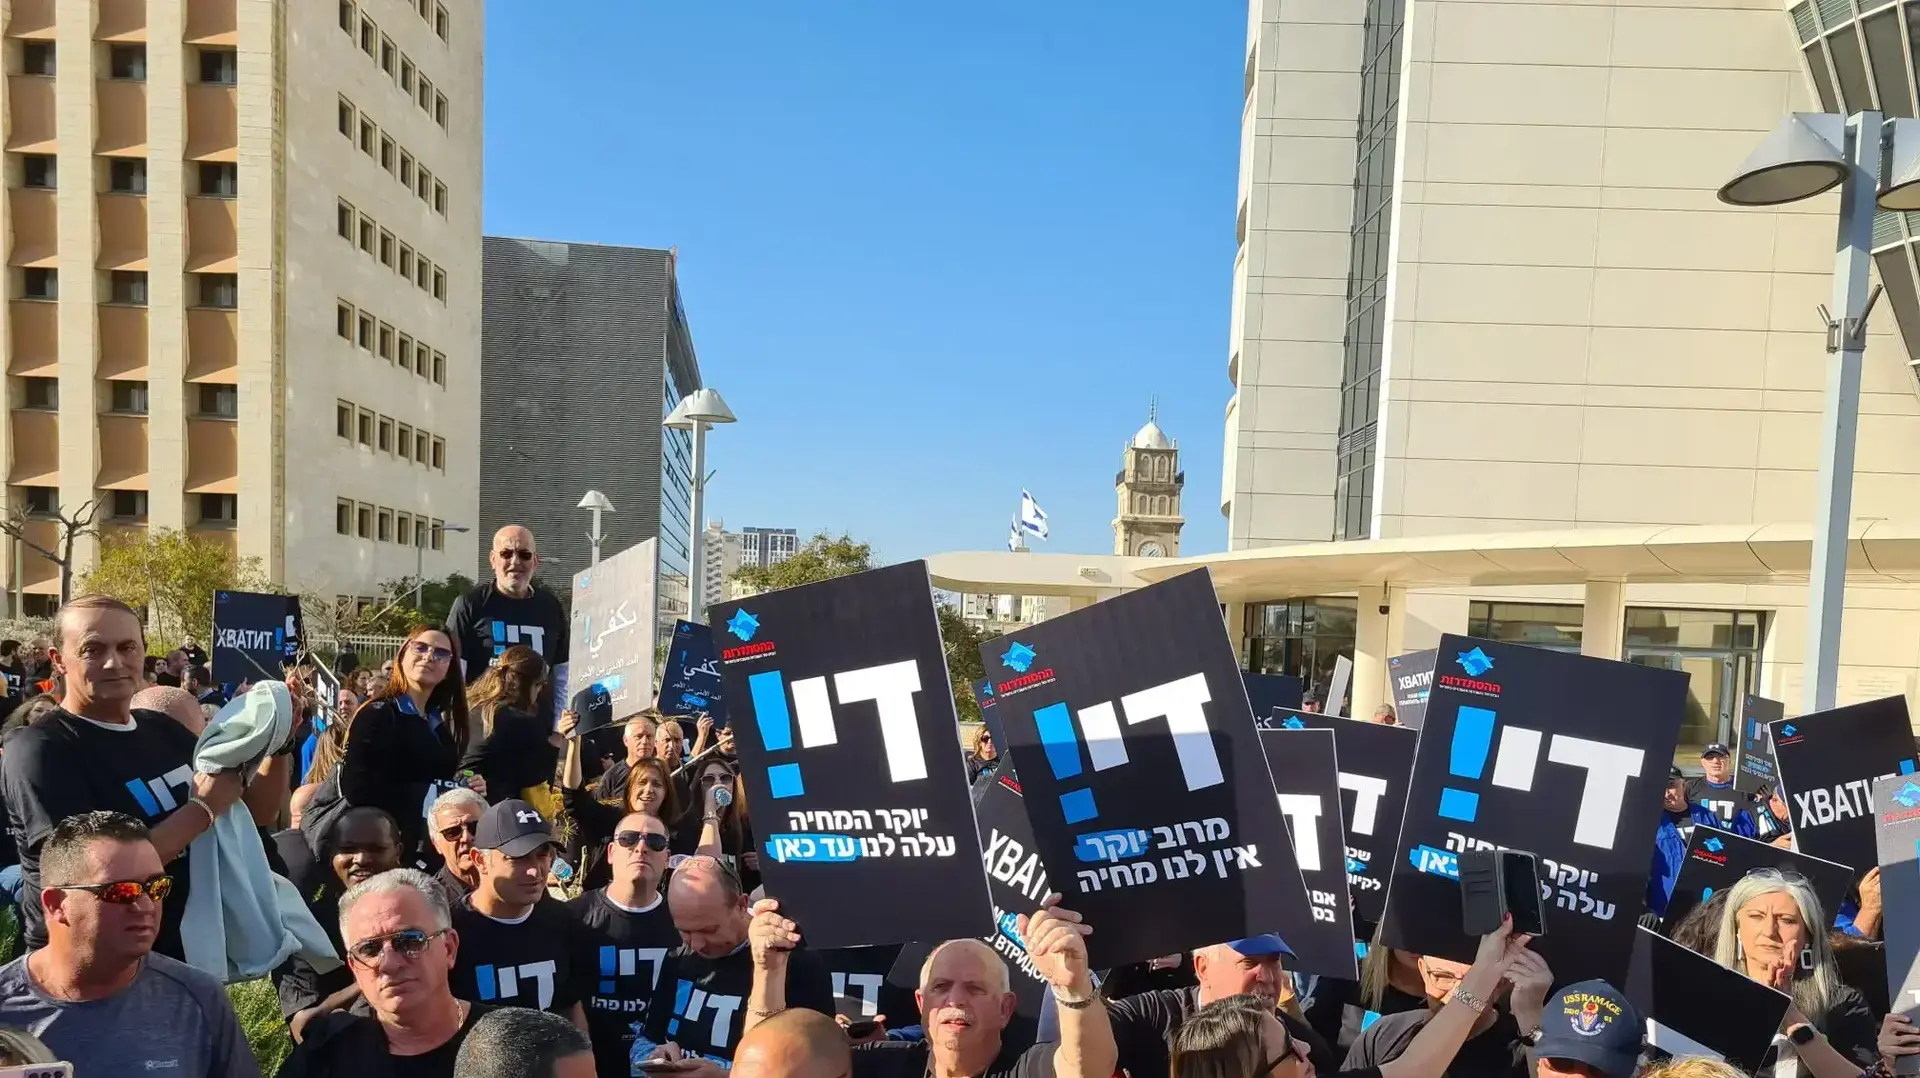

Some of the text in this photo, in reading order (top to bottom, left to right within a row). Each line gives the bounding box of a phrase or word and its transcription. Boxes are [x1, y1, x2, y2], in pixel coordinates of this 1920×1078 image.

[749, 660, 928, 799] די!
[1033, 672, 1225, 824] די!
[1438, 705, 1645, 850] די!
[1793, 759, 1916, 829] ХВАТИ
[788, 808, 929, 835] יוקר המחיה
[1085, 817, 1231, 862] מרוב יוקר
[774, 831, 956, 864] עלה לנו עד כאן
[1076, 844, 1263, 893] אין לנו מחיה
[1543, 858, 1599, 888] יוקר
[1556, 888, 1616, 921] עלה
[590, 996, 620, 1011] פה!
[667, 979, 743, 1048] די!
[1563, 993, 1623, 1016] USS RAMAGE
